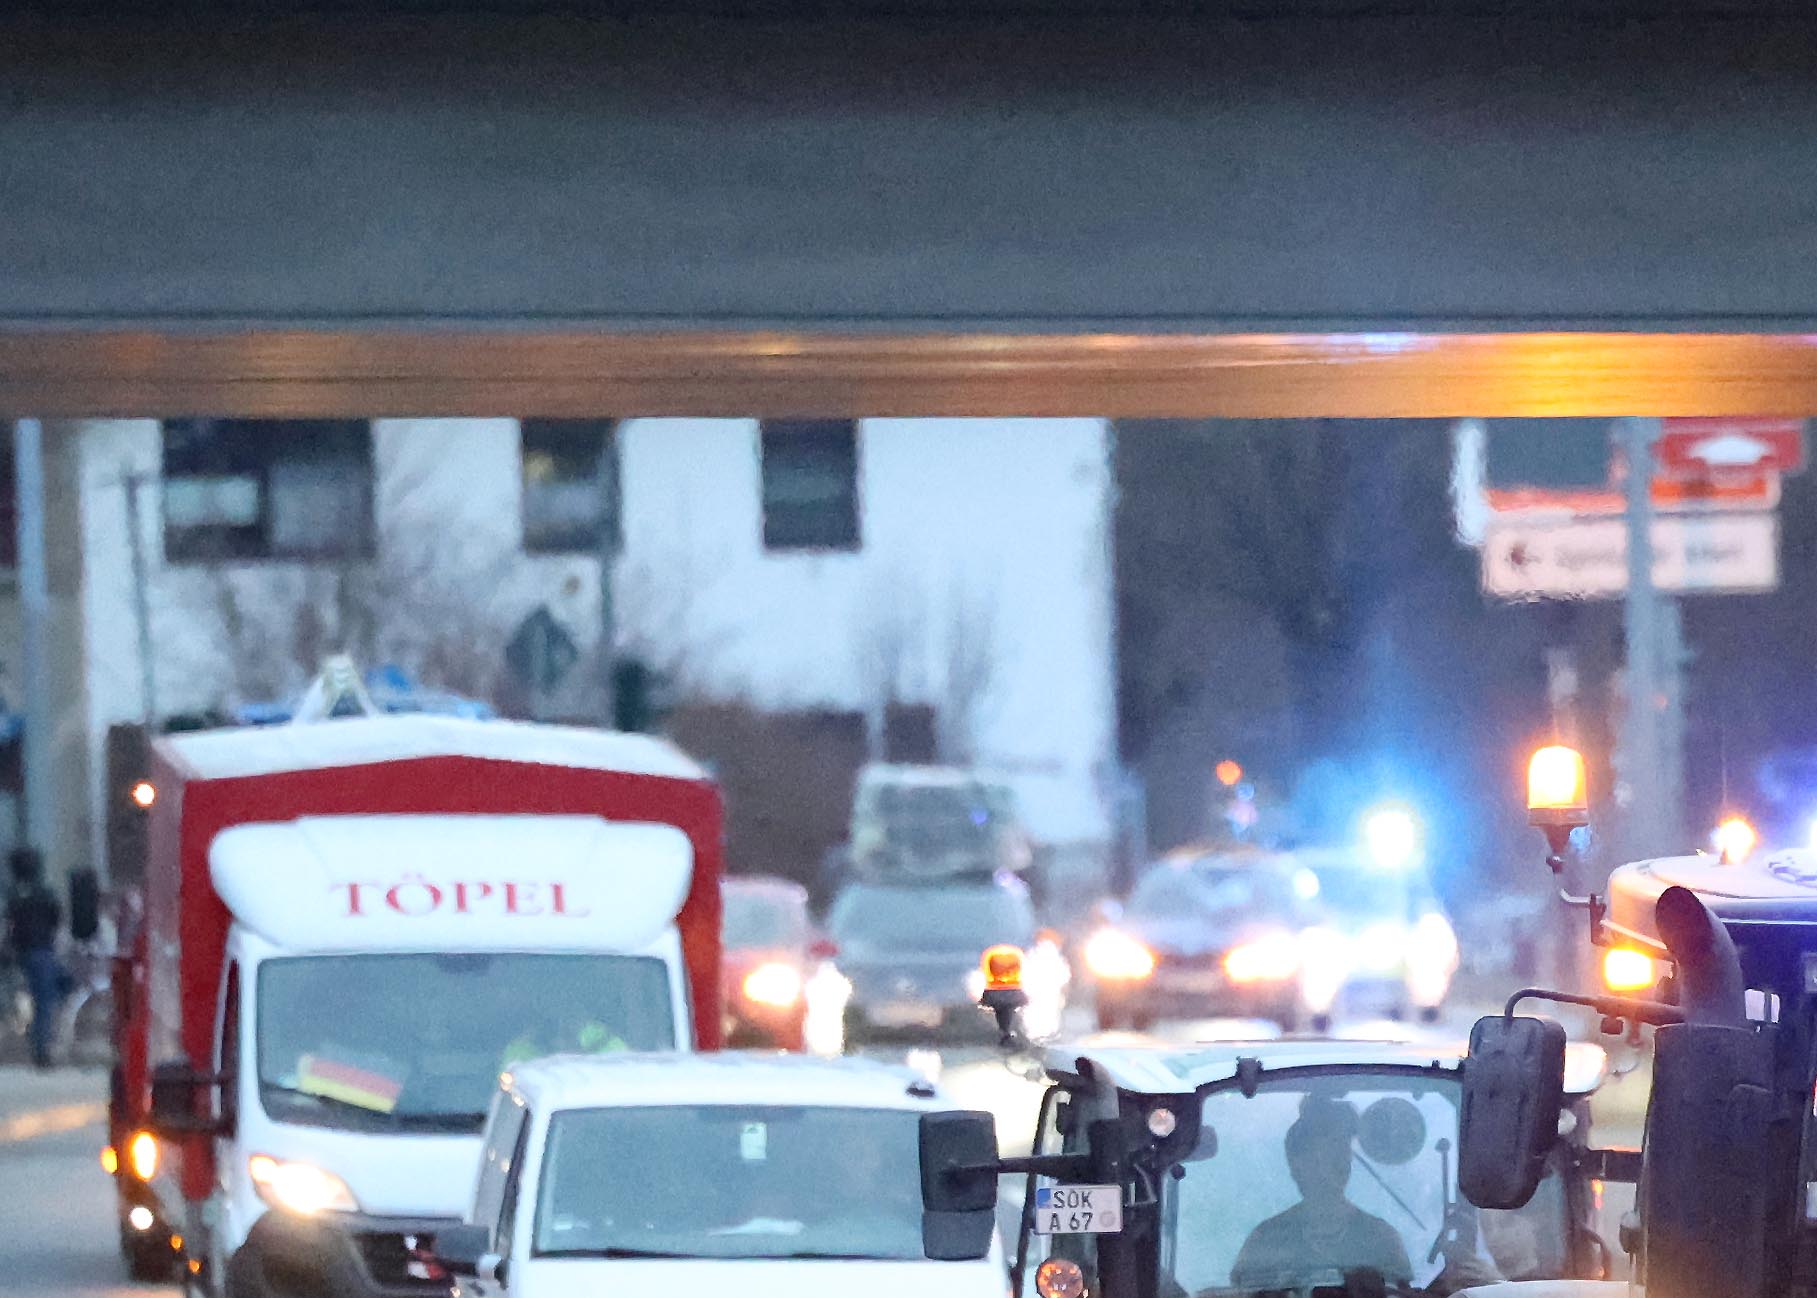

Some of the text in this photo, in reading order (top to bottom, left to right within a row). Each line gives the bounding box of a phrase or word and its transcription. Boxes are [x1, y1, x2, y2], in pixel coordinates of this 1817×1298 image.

[328, 872, 591, 918] TÖPEL
[1053, 1190, 1093, 1209] SOK
[1049, 1212, 1093, 1231] A 67
